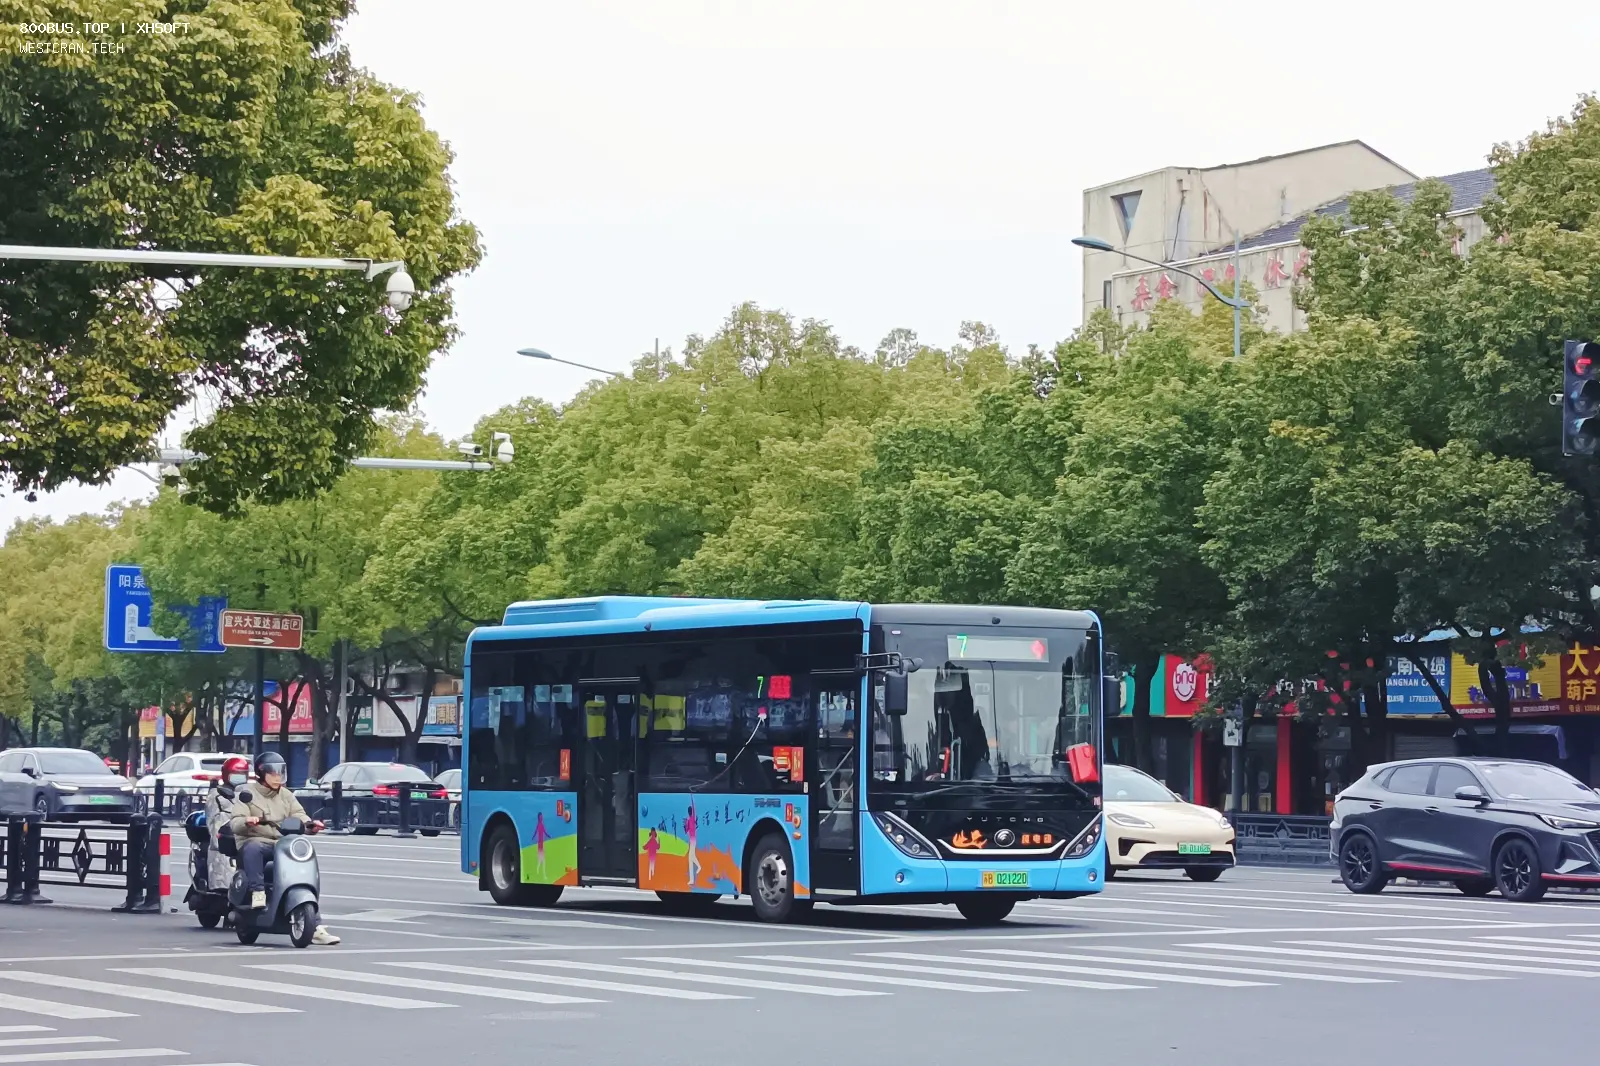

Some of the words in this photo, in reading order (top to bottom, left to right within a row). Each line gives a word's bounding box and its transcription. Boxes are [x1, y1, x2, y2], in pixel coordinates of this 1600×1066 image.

[224, 615, 290, 631] 宜兴大亚达酒店
[956, 632, 967, 659] 7
[757, 676, 764, 699] 7
[1385, 678, 1419, 687] IANGNAN
